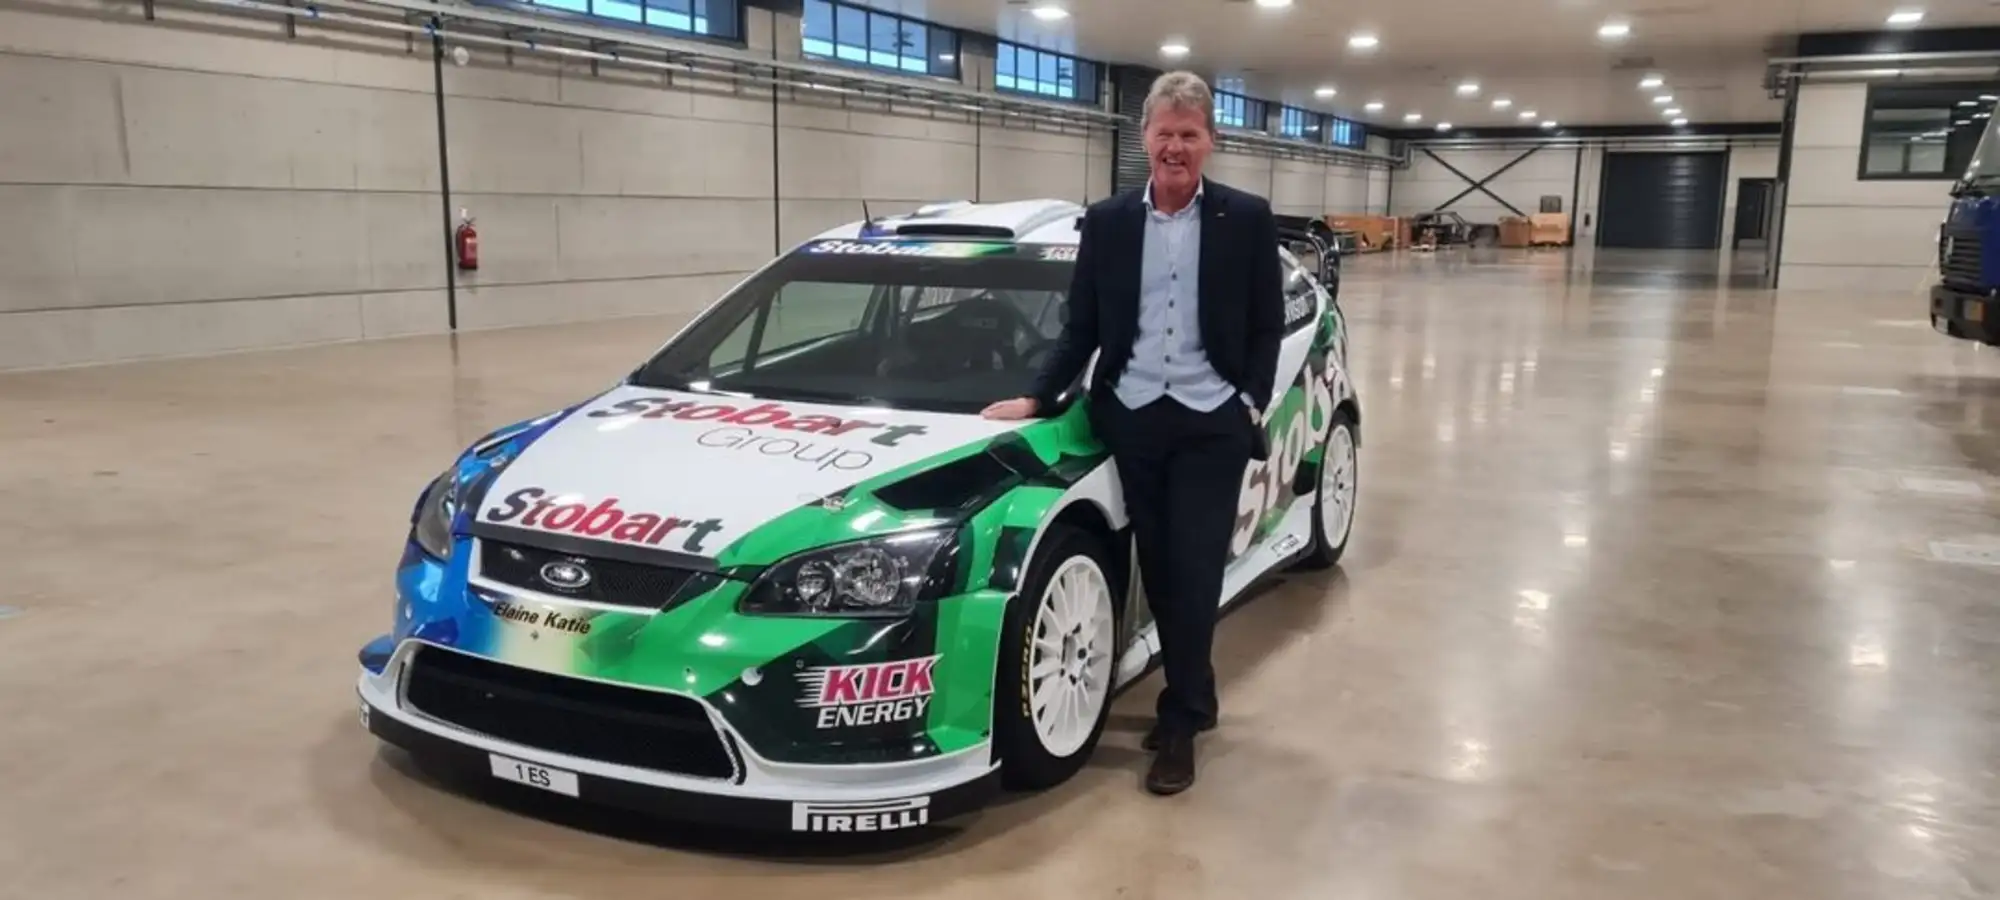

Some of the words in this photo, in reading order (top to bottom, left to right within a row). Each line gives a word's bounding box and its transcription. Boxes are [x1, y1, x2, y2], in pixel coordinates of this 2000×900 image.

[588, 396, 928, 448] Stobart
[696, 426, 874, 471] Group
[487, 486, 723, 554] Stobart
[493, 603, 539, 626] Elaine
[543, 611, 592, 635] Katie
[818, 652, 944, 706] KICK
[816, 695, 932, 729] ENERGY
[515, 764, 525, 780] 1
[528, 767, 551, 788] ES
[792, 795, 931, 832] PIRELLI
